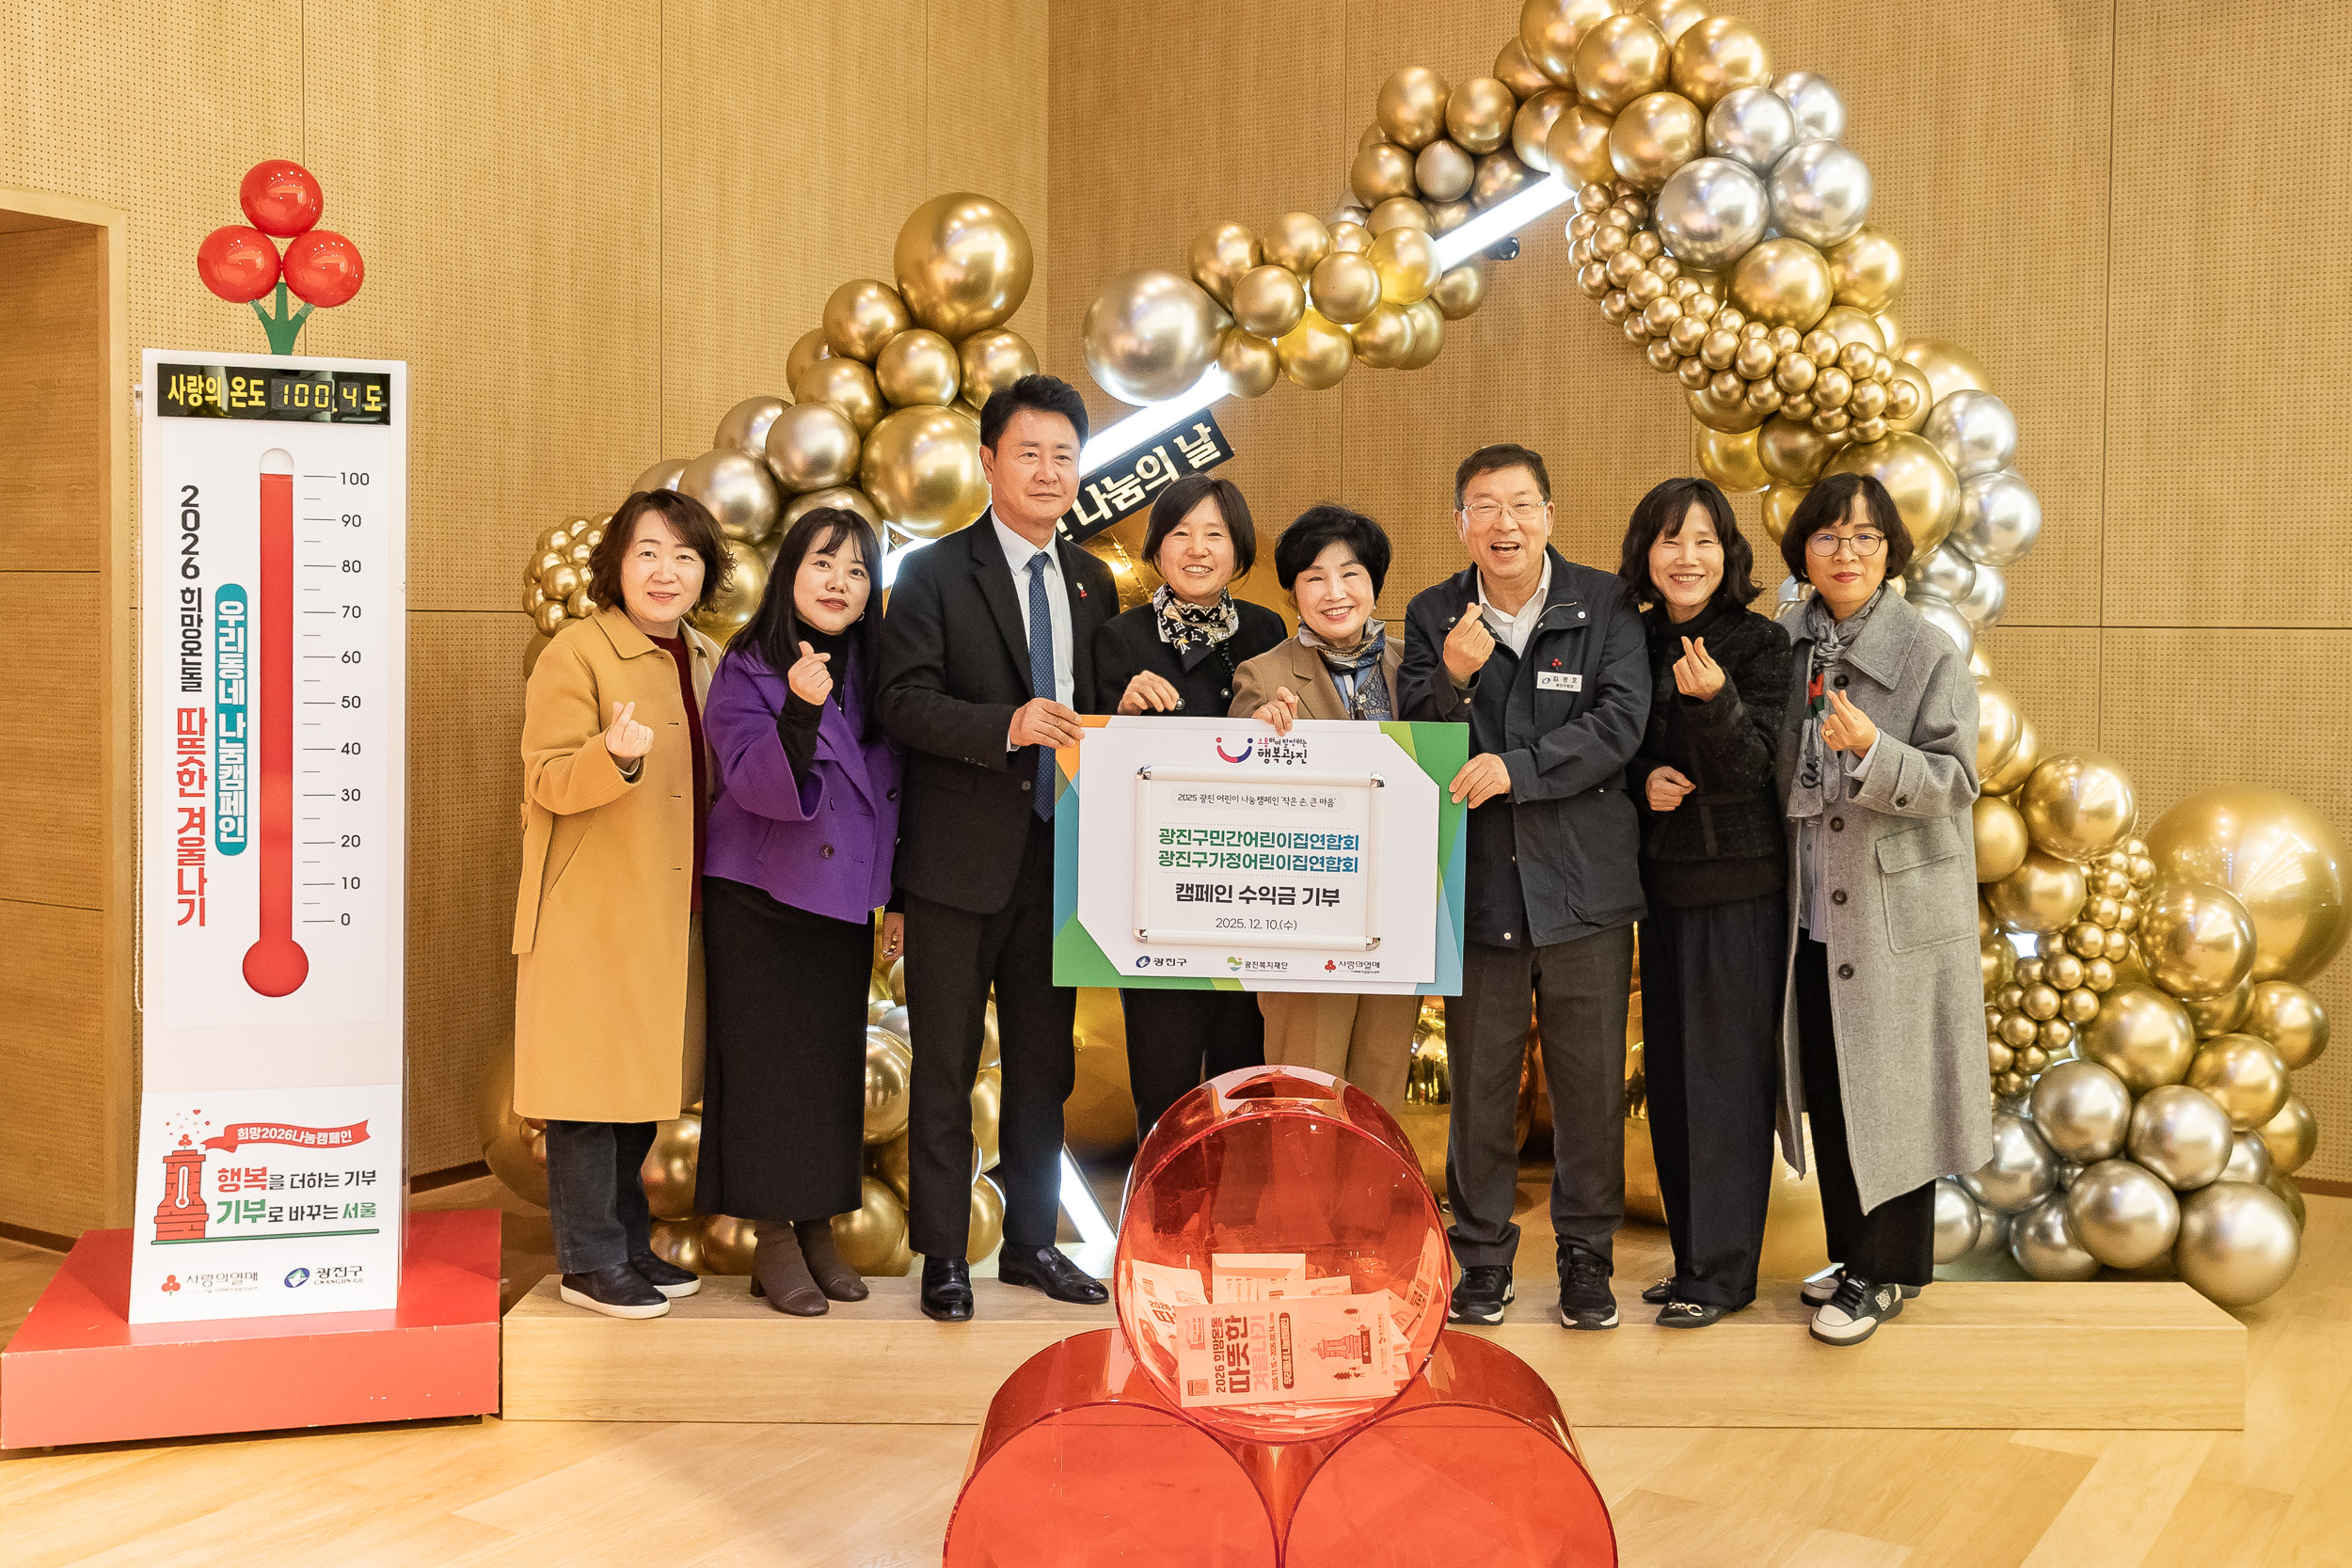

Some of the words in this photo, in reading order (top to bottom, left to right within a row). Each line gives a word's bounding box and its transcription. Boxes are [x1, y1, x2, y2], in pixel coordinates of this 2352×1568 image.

[167, 374, 222, 407] 사랑의
[230, 376, 266, 408] 온도
[340, 472, 370, 486] 100
[1071, 445, 1181, 527] 나눔의
[1173, 421, 1222, 469] 날
[342, 515, 361, 528] 90
[181, 484, 200, 580] 2026
[342, 560, 361, 574] 80
[342, 606, 361, 619] 70
[180, 587, 203, 693] 희망온돌
[218, 600, 245, 706] 우리동네
[342, 651, 361, 664] 60
[342, 695, 361, 708] 50
[176, 707, 208, 798] 따뜻한
[341, 742, 361, 755] 40
[1257, 747, 1307, 766] 행복광진
[218, 712, 246, 843] 나눔캠페인
[341, 789, 361, 801] 30
[1200, 794, 1215, 804] 광진
[1216, 794, 1239, 804] 어린이
[1310, 797, 1317, 807] 큰
[341, 835, 361, 847] 20
[1158, 828, 1359, 851] 광진구민간어린이집연합회
[177, 806, 207, 927] 겨울나기
[1158, 850, 1359, 873] 광진구가정어린이집연합회
[342, 877, 361, 889] 10
[1175, 882, 1233, 904] 캠페인
[1238, 884, 1296, 906] 수익금
[1302, 887, 1341, 908] 기부
[341, 913, 351, 926] 0
[1216, 917, 1247, 929] 2025.
[1248, 918, 1263, 929] 12.
[1152, 958, 1187, 967] 광진구
[1245, 960, 1288, 970] 광진복지재단
[1338, 960, 1380, 970] 사랑의열매
[237, 1127, 353, 1146] 희망2026나눔캠페인
[217, 1166, 284, 1193] 행복을
[290, 1172, 340, 1190] 더하는
[344, 1169, 376, 1186] 기부
[216, 1198, 284, 1225] 기부로
[289, 1204, 339, 1222] 바꾸는
[342, 1202, 376, 1219] 서울
[185, 1271, 259, 1288] 사랑의열매
[316, 1265, 363, 1279] 광진구
[1225, 1315, 1250, 1394] 따뜻한
[1249, 1315, 1268, 1392] 겨울나기
[1214, 1365, 1226, 1393] 2026
